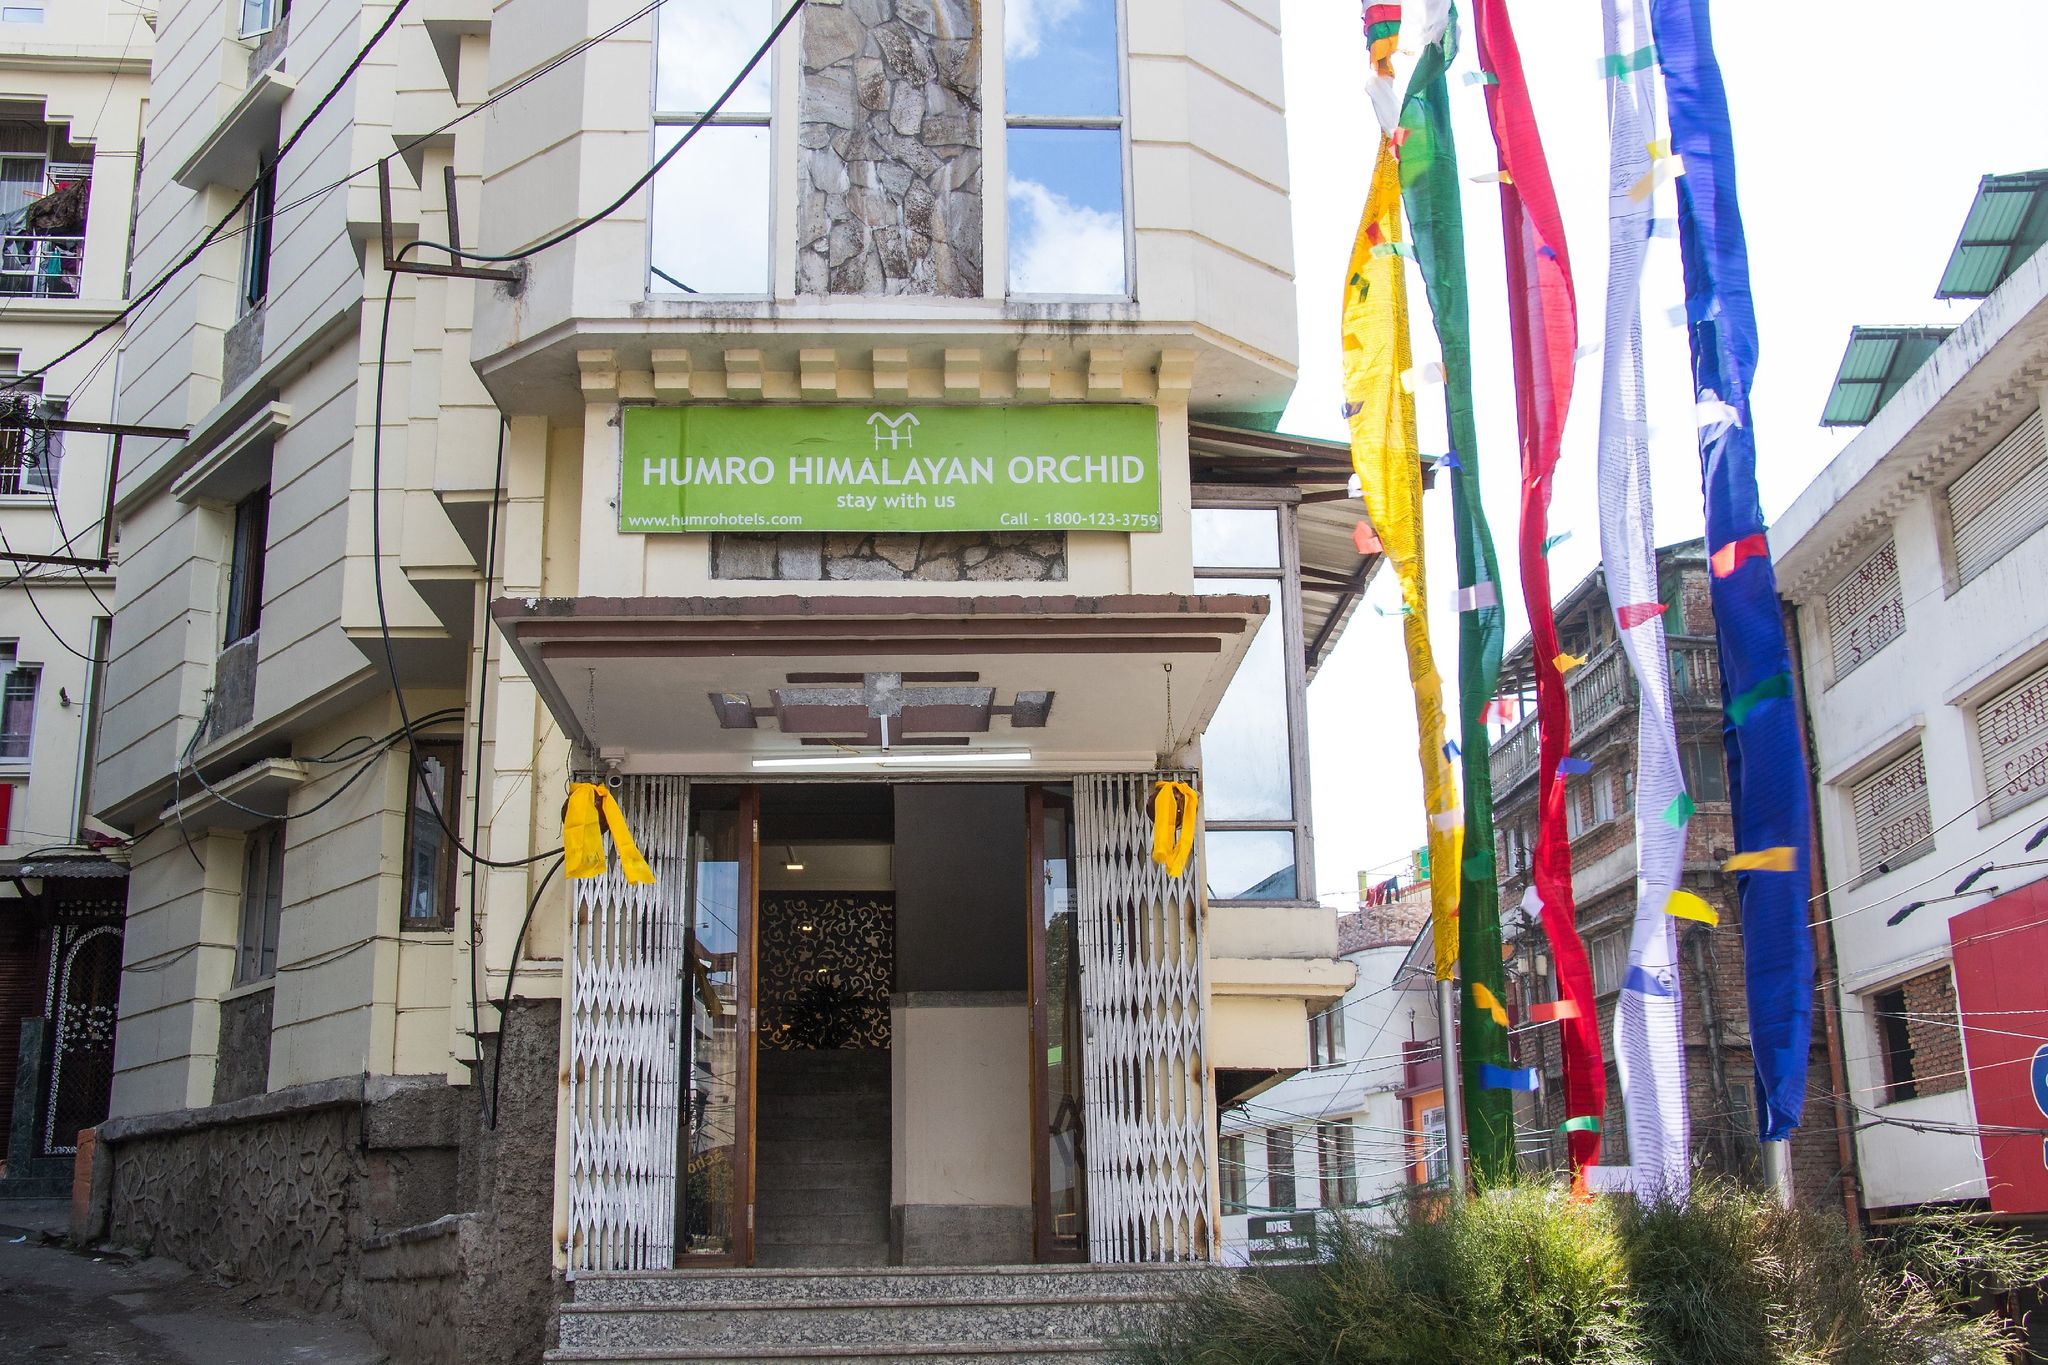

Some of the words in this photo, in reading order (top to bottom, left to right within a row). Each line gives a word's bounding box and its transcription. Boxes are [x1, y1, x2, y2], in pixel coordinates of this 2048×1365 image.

[643, 456, 775, 486] HUMRO
[789, 456, 993, 485] HIMALAYAN
[1007, 455, 1144, 484] ORCHID
[836, 493, 877, 512] stay
[884, 492, 927, 508] with
[934, 495, 956, 508] us
[628, 512, 802, 527] www.humrohotels.com
[1000, 512, 1028, 526] Call
[1045, 512, 1158, 527] 1800-123-3759
